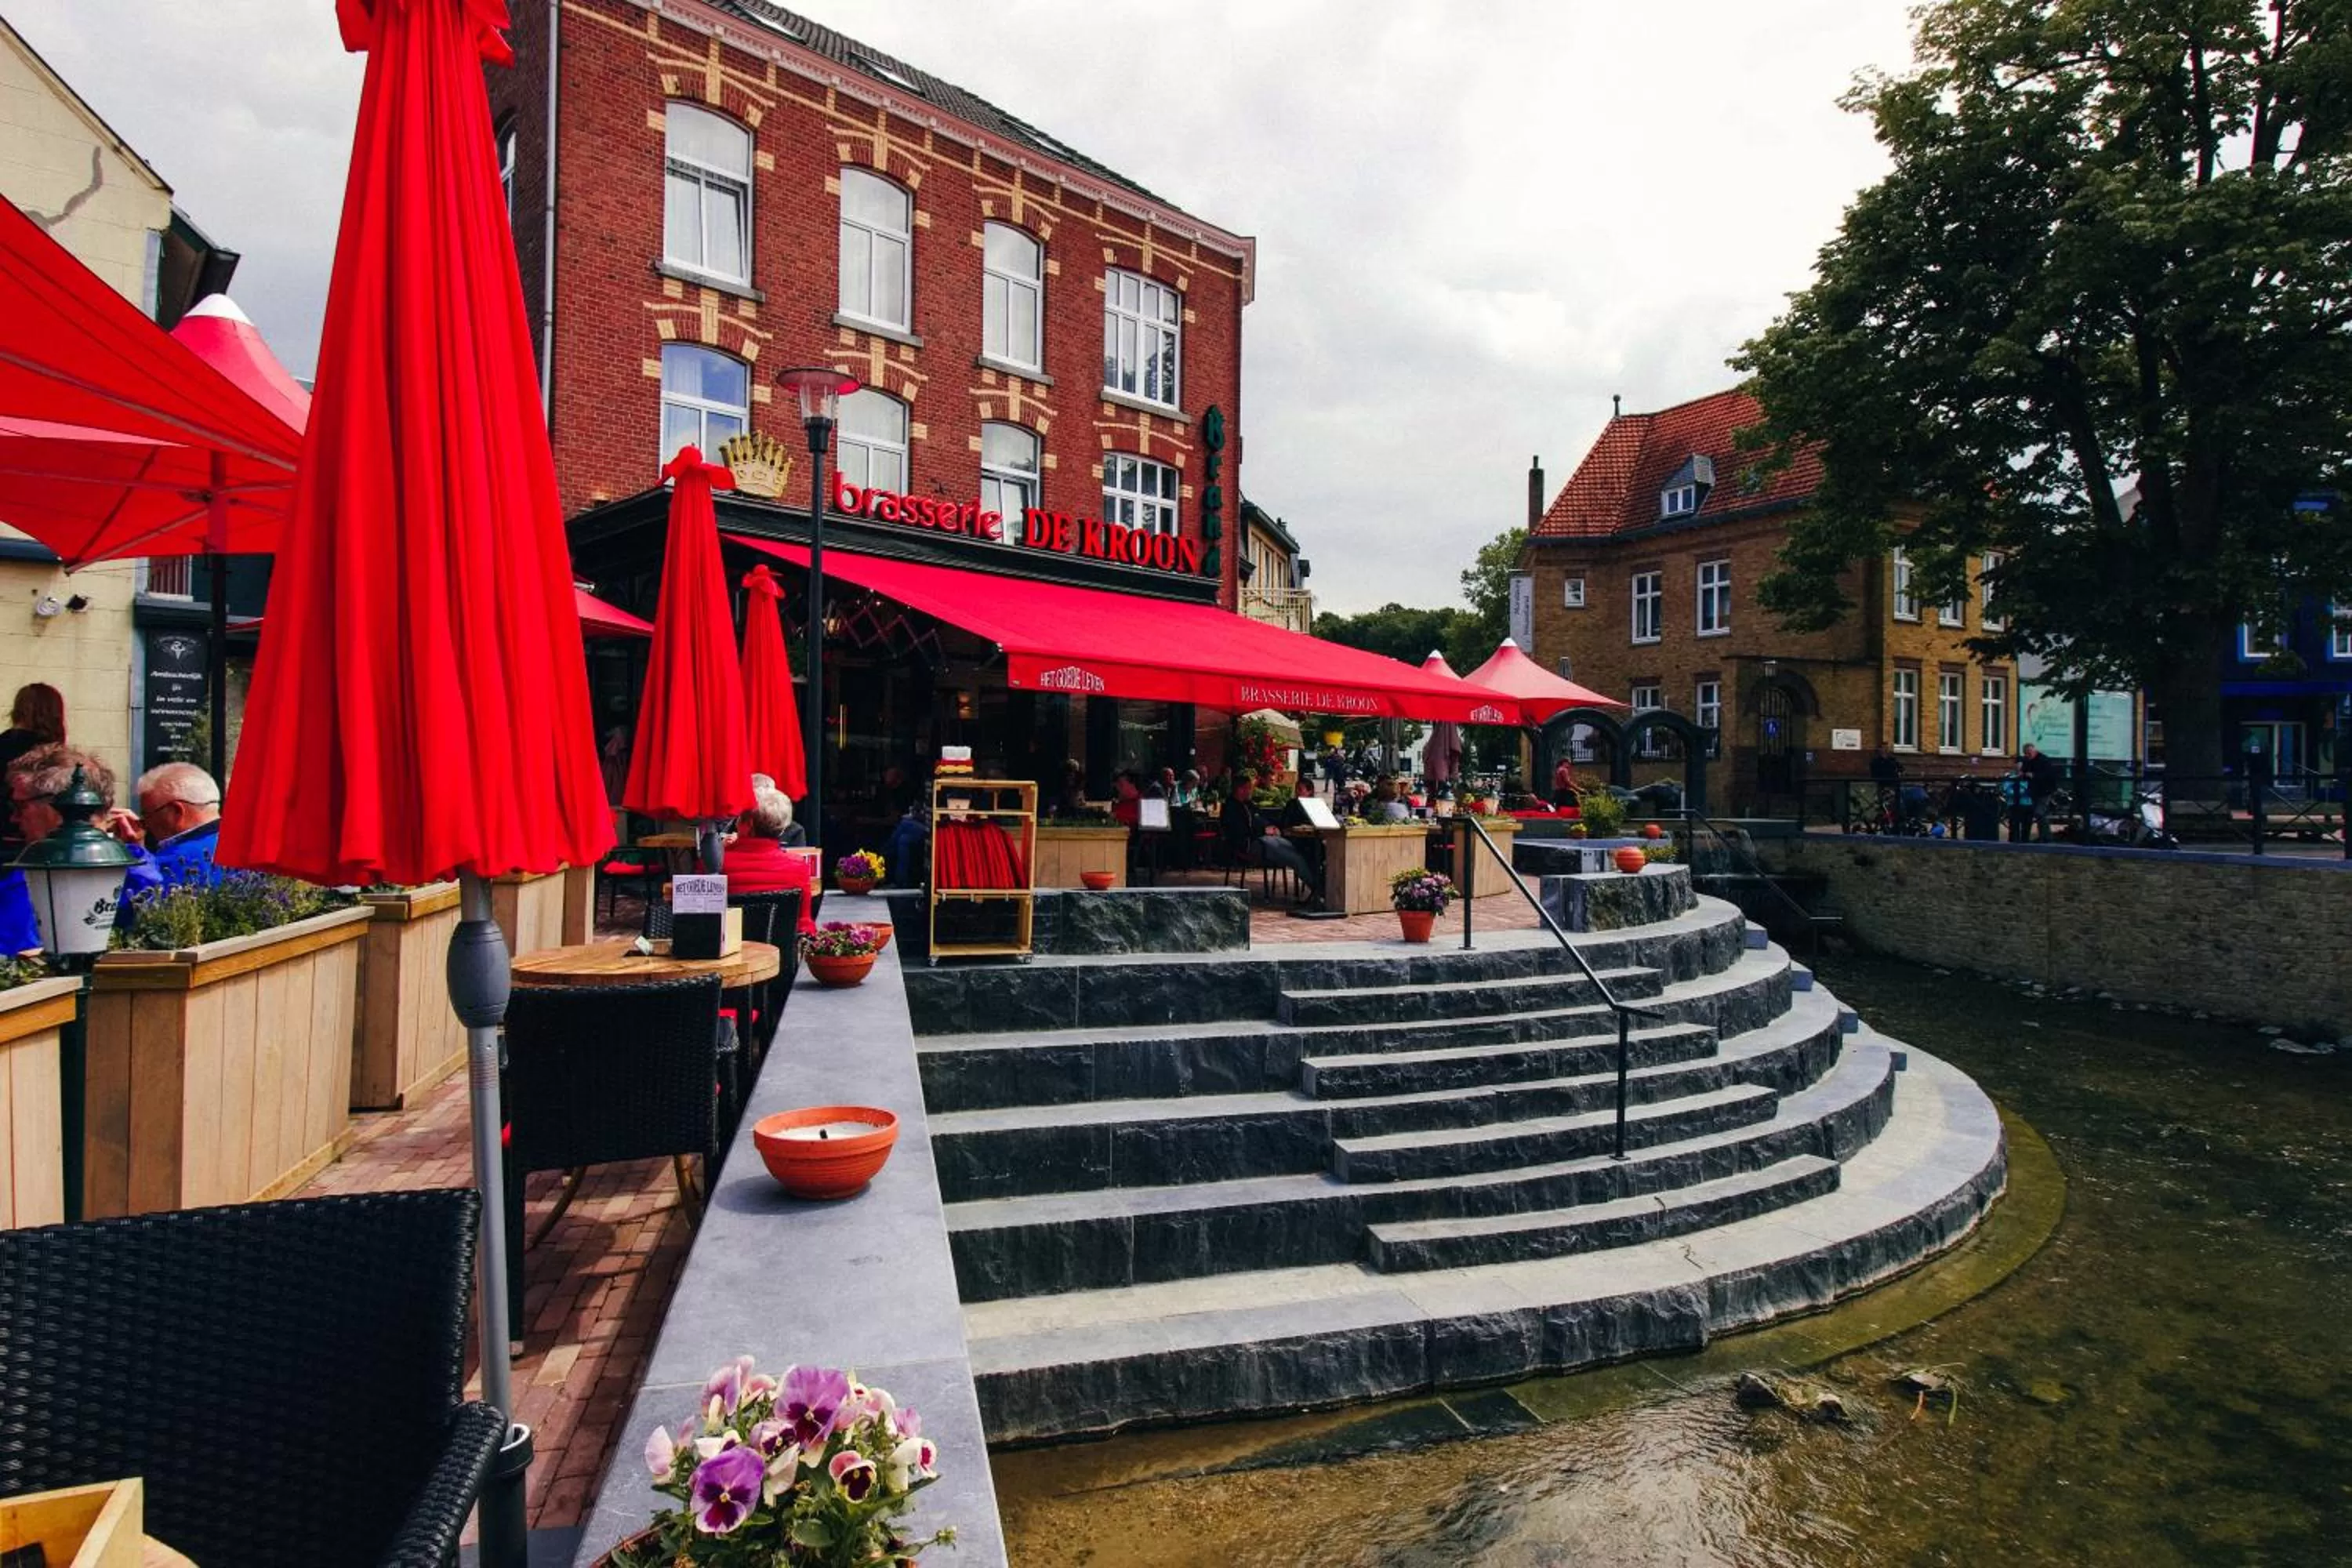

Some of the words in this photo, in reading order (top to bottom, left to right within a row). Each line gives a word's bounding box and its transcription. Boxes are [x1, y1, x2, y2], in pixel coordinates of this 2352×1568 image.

[833, 471, 1004, 540] brasserie
[1023, 507, 1072, 552] DE
[1080, 517, 1199, 573] KROON
[1205, 405, 1224, 577] Brand
[1040, 670, 1055, 687] HET
[1081, 670, 1105, 692] LEVEN
[1241, 686, 1313, 706] BRASSERIE
[1316, 693, 1334, 707] DE
[1336, 693, 1380, 711] KROON
